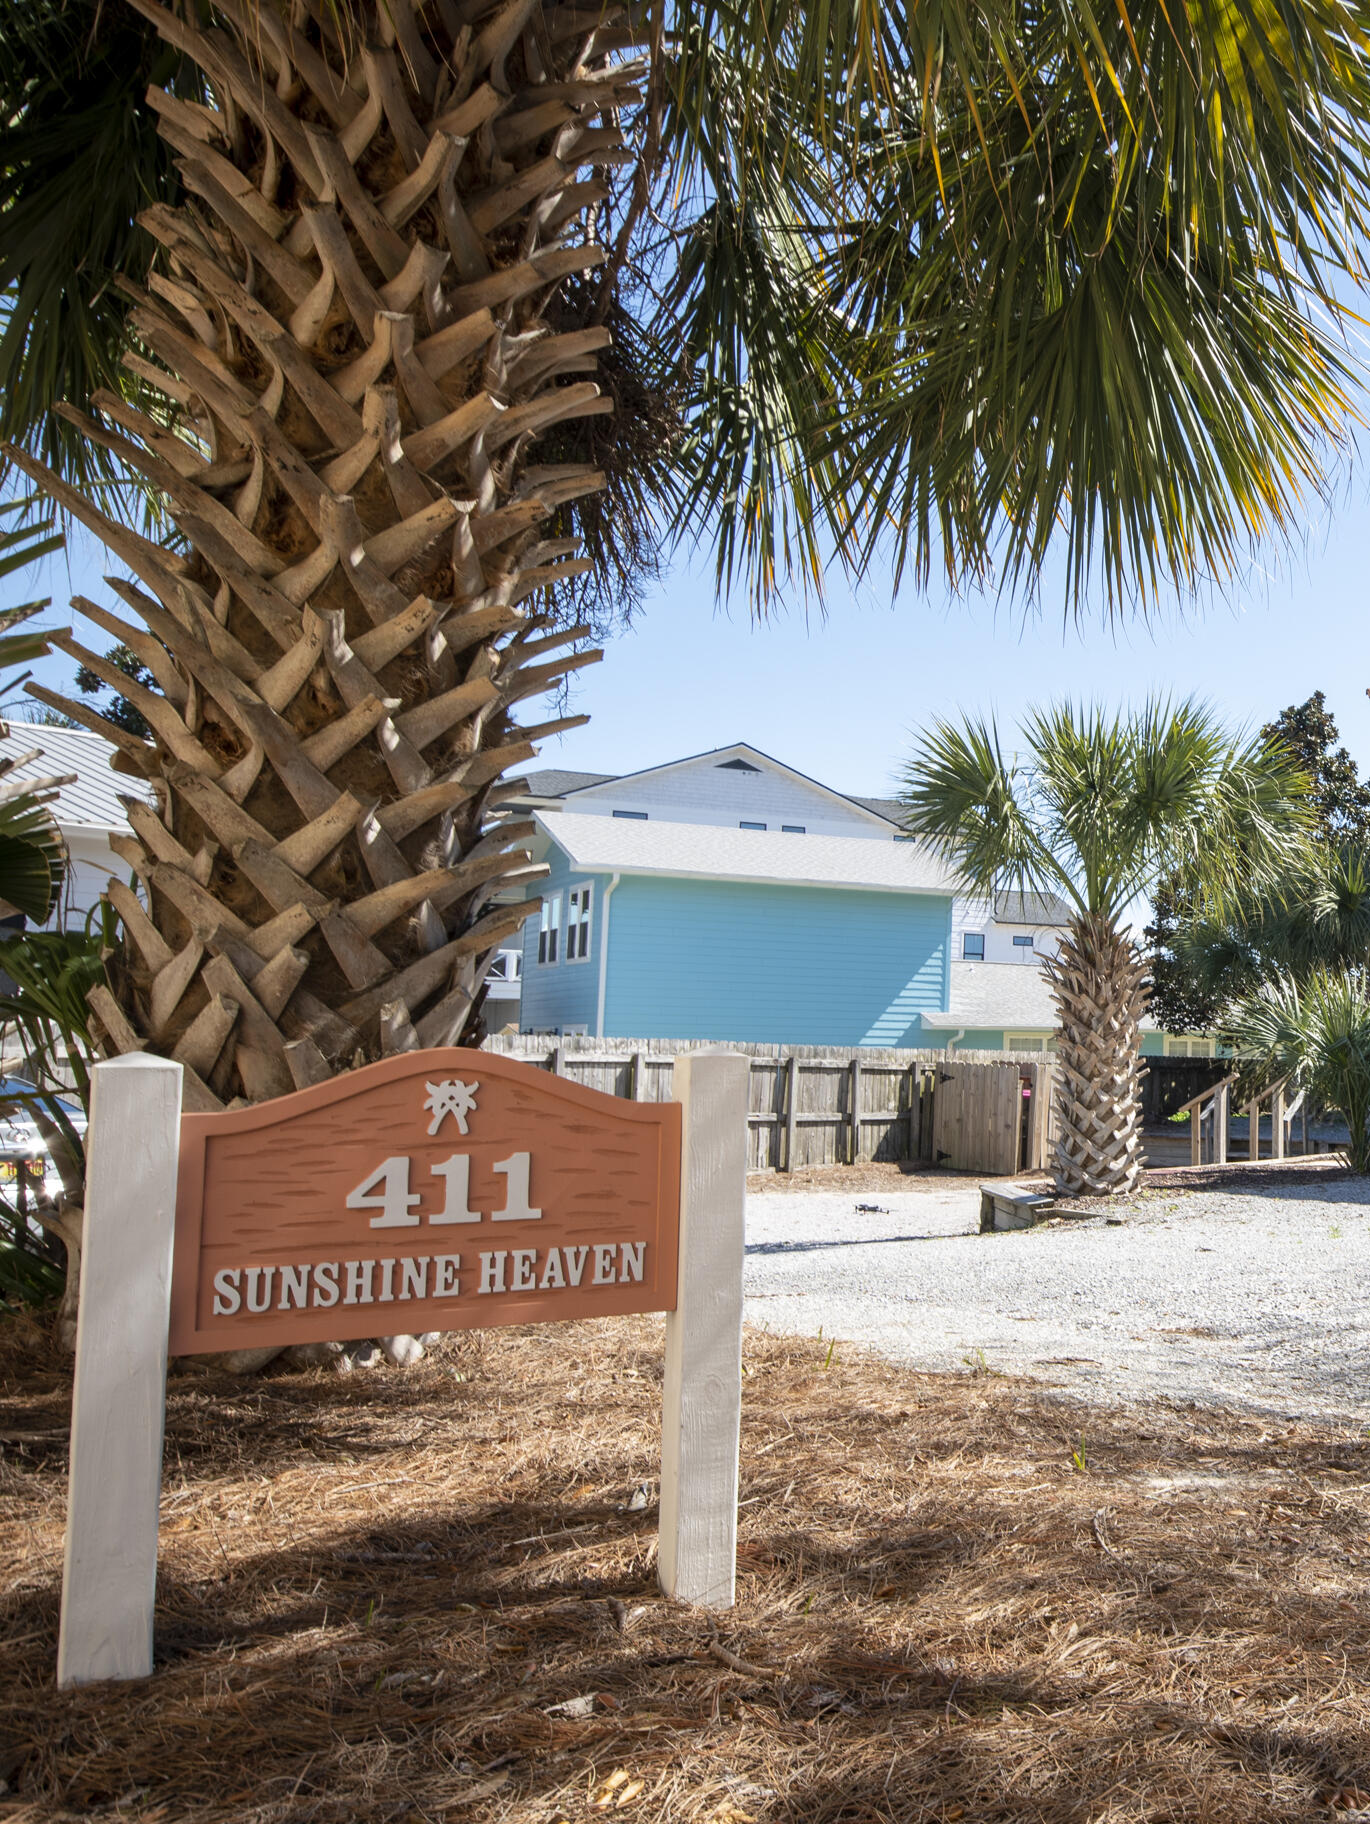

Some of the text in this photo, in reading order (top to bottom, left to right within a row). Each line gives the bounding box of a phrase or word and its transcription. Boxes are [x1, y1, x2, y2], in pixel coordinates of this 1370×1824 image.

[346, 1152, 542, 1229] 411
[213, 1242, 647, 1315] SUNSHINE HEAVEN
